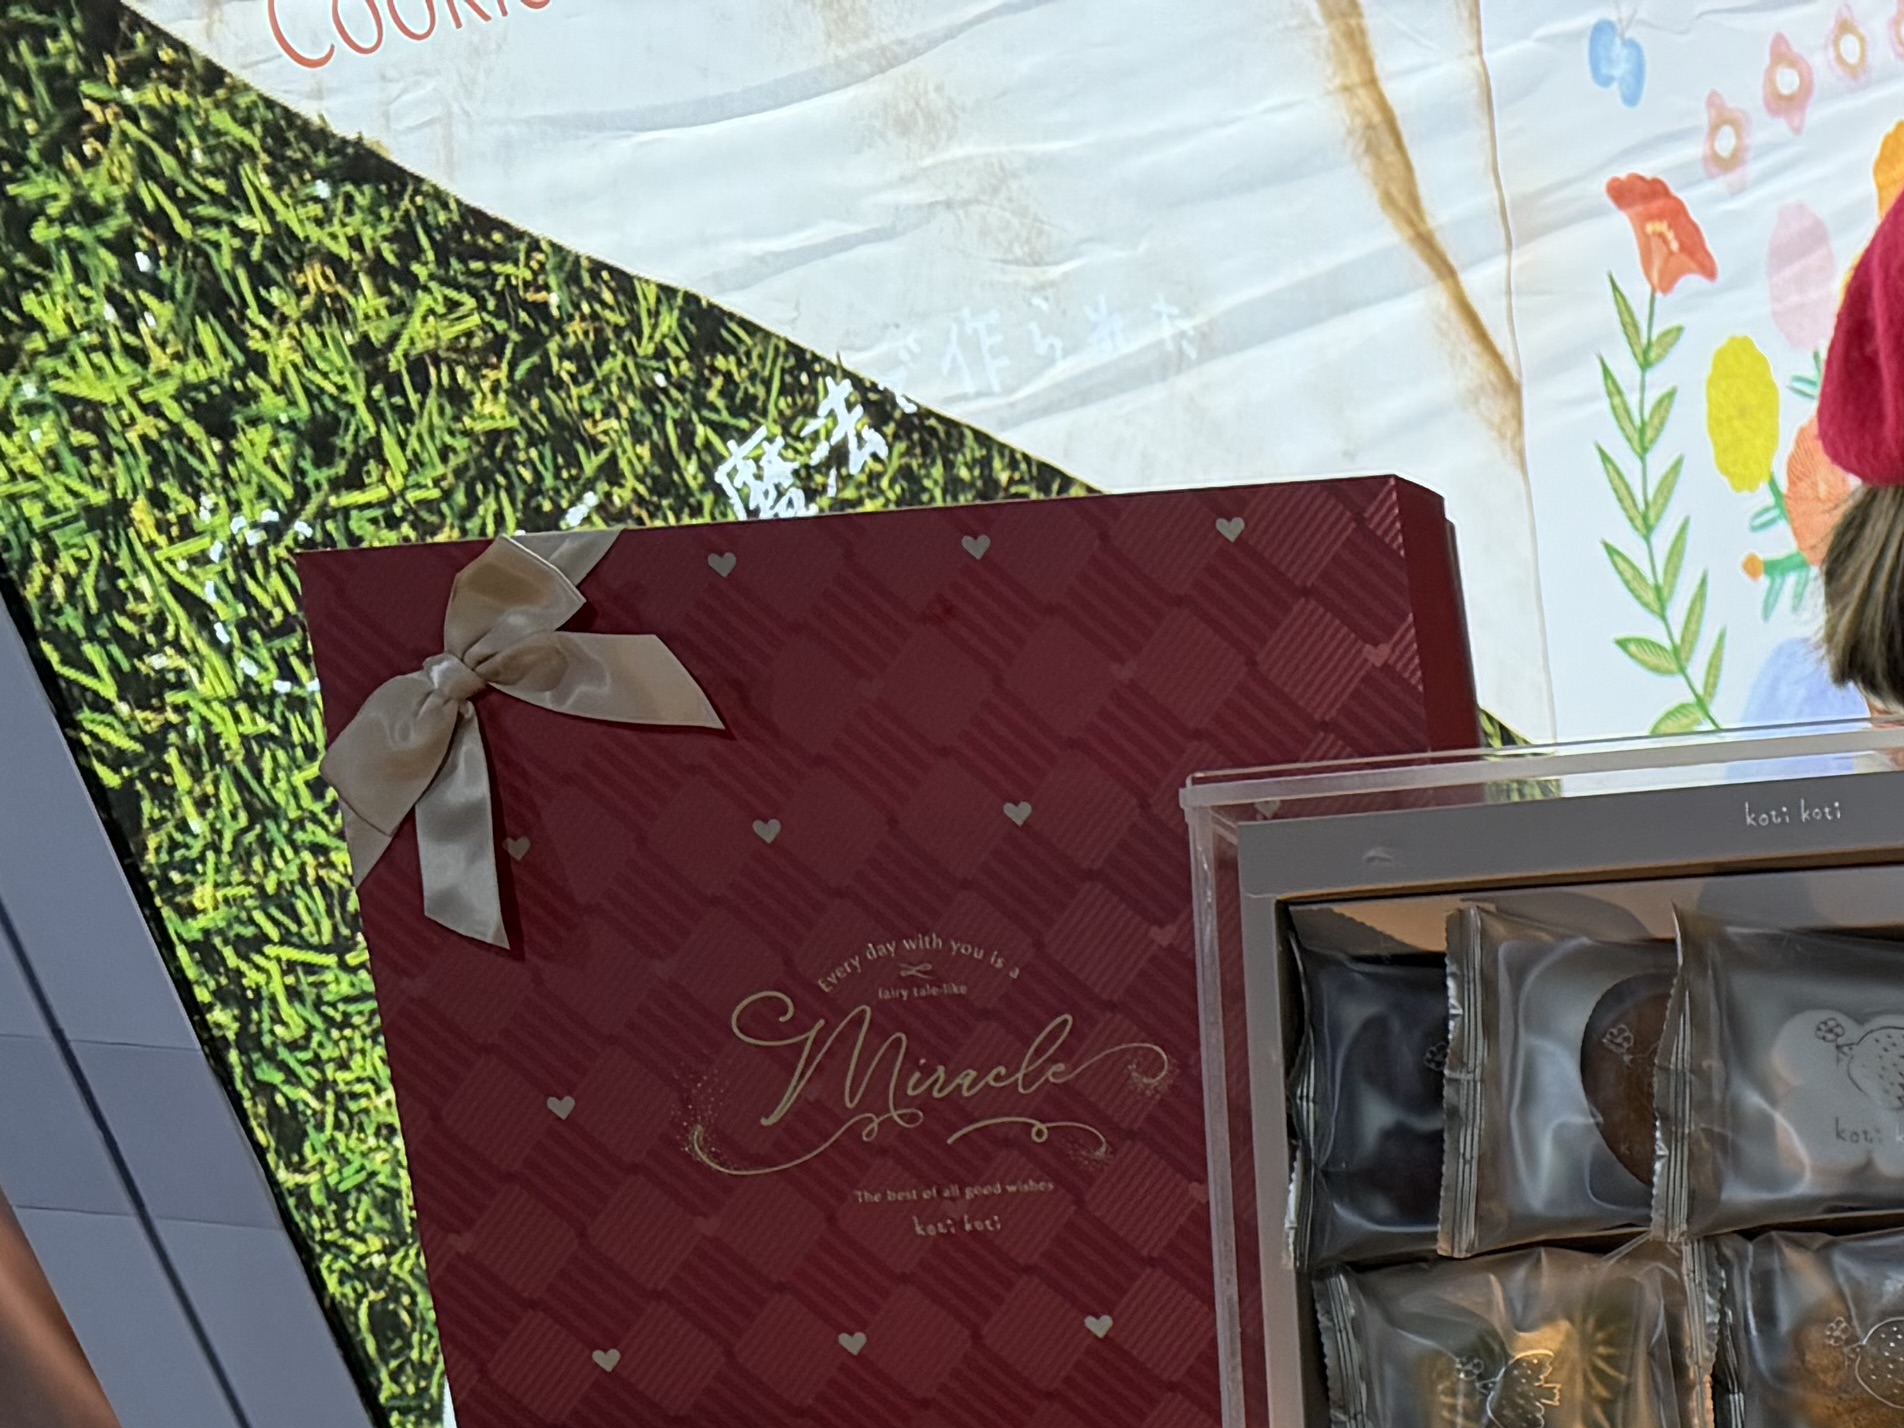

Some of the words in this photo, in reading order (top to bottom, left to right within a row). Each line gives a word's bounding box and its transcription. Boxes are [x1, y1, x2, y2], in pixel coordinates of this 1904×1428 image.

[1745, 801, 1790, 827] koti
[1800, 798, 1841, 822] koti
[816, 954, 863, 993] Every
[865, 940, 896, 961] day
[902, 932, 943, 950] with
[950, 940, 984, 960] you
[990, 950, 1006, 969] is
[1009, 967, 1021, 980] a
[878, 986, 909, 1001] fairy
[728, 990, 1100, 1130] Miracle
[855, 1189, 882, 1204] The
[886, 1189, 918, 1202] best
[922, 1187, 938, 1200] of
[942, 1184, 960, 1199] all
[965, 1182, 1002, 1200] good
[1005, 1179, 1055, 1194] wishes
